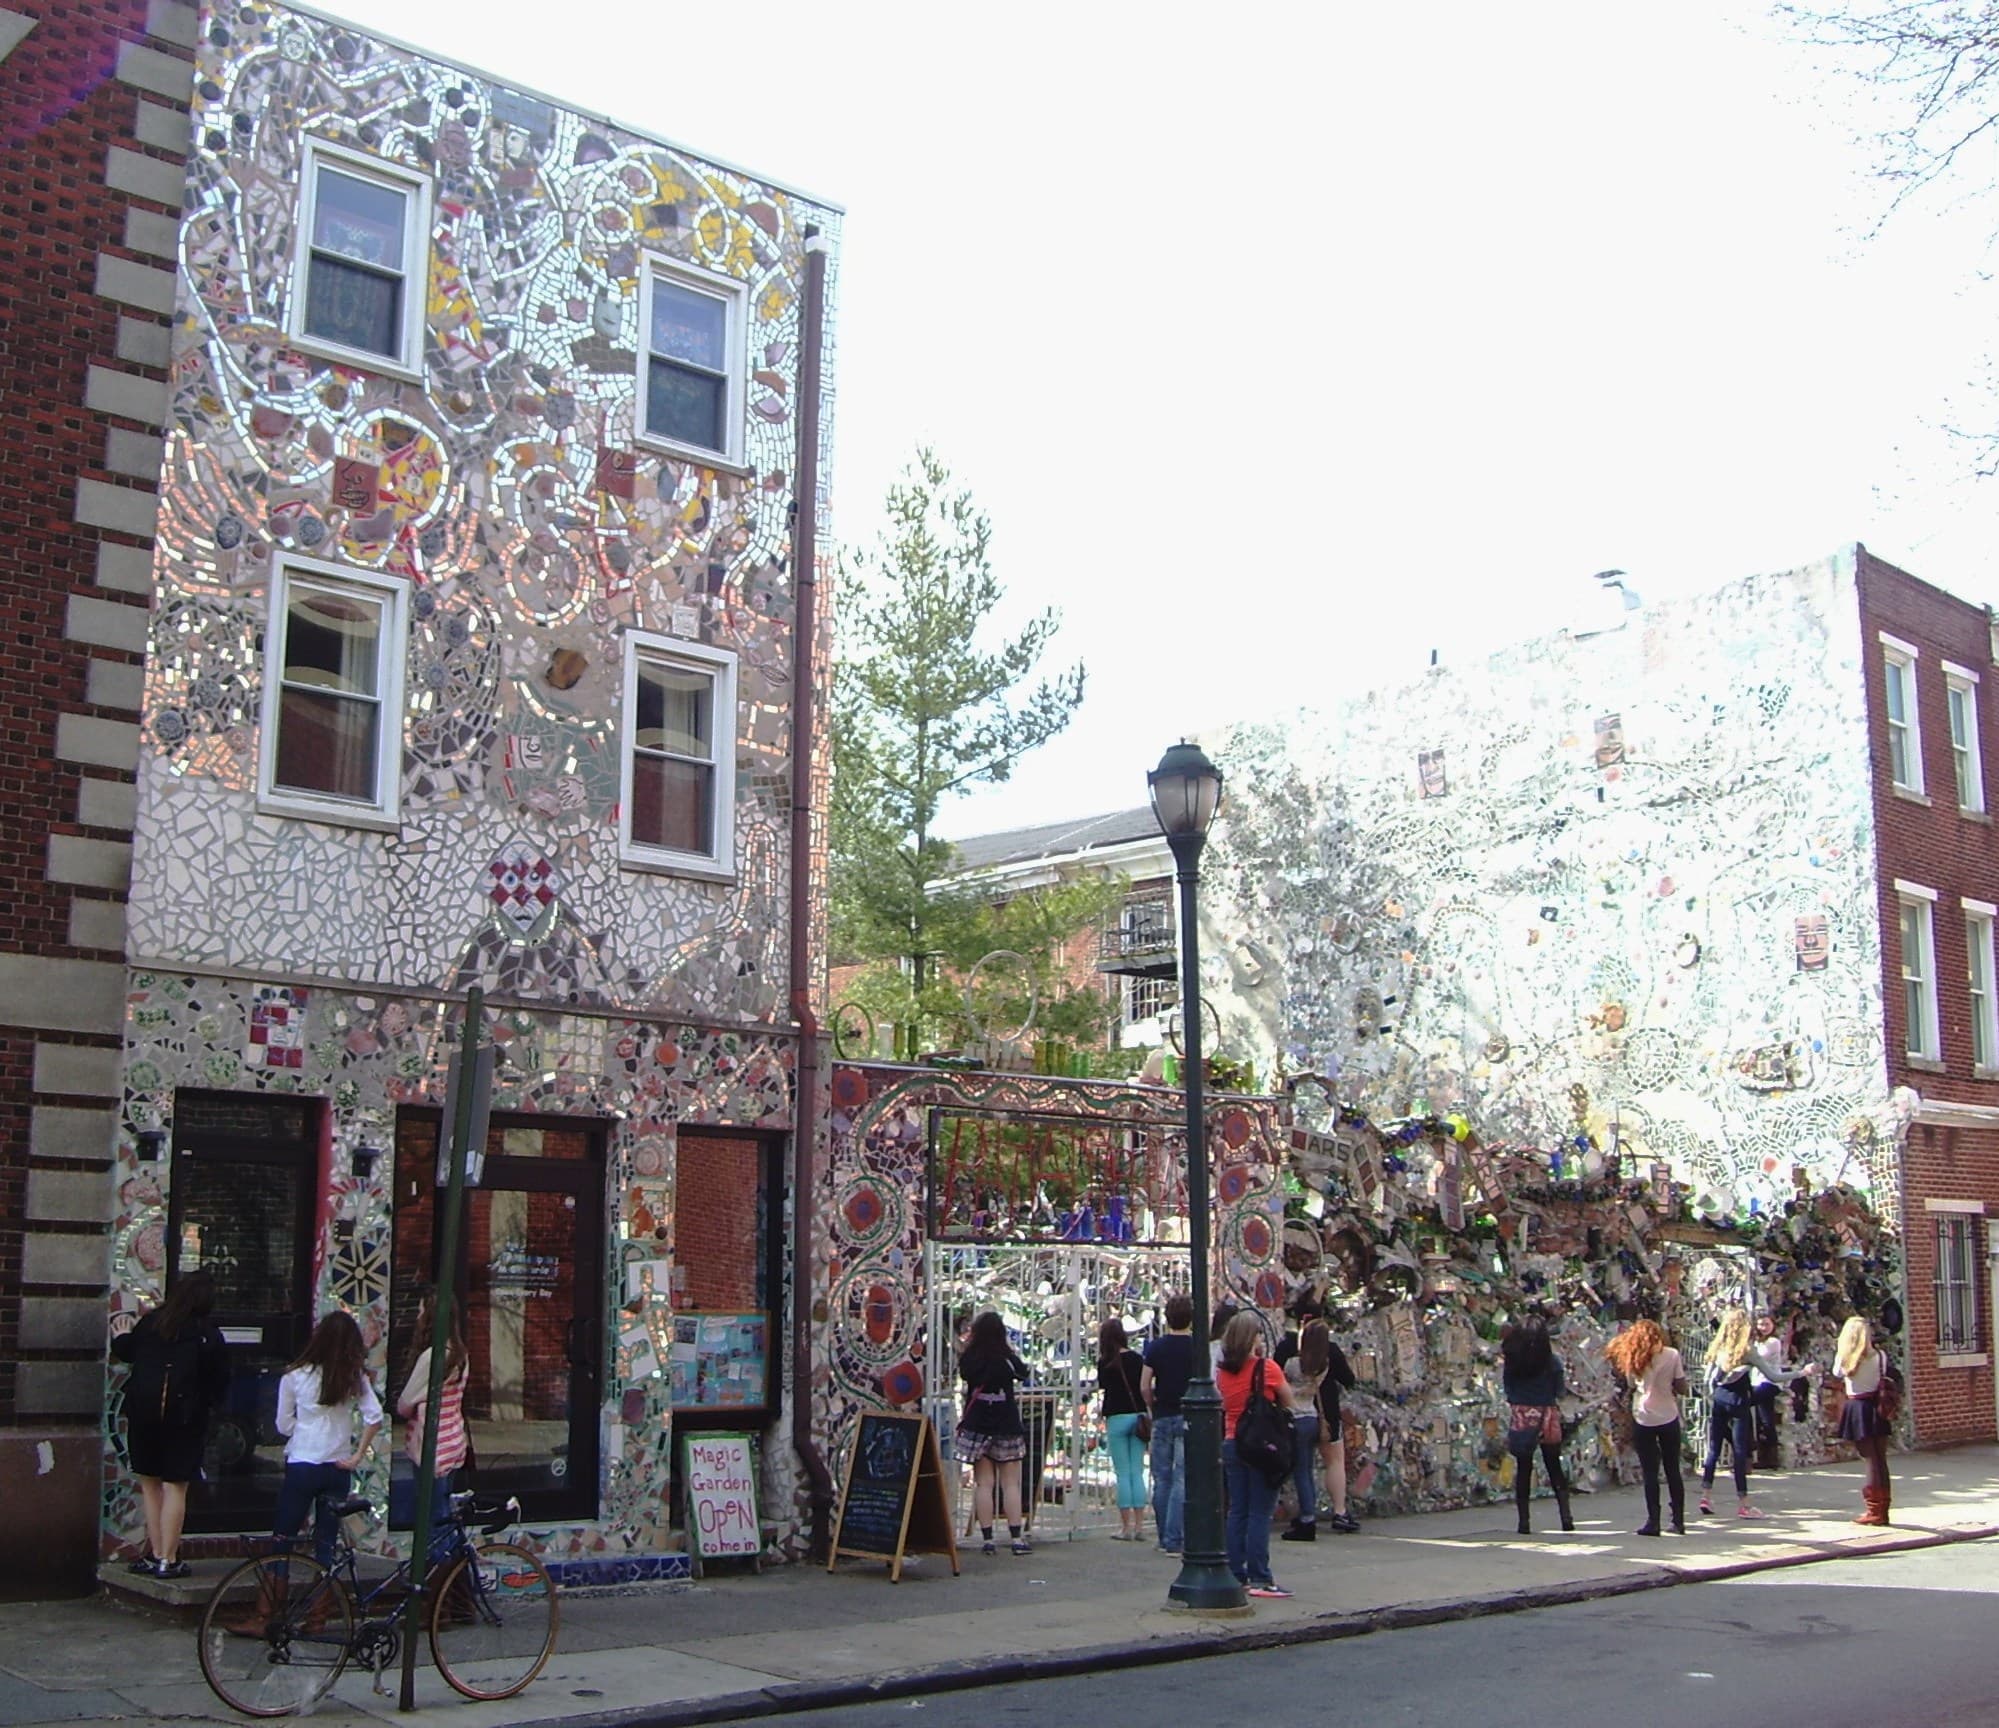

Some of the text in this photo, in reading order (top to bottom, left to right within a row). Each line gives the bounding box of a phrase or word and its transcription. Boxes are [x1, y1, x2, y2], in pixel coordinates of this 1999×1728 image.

[693, 1447, 742, 1471] Magic
[692, 1467, 751, 1491] Garden
[703, 1537, 757, 1553] come in
